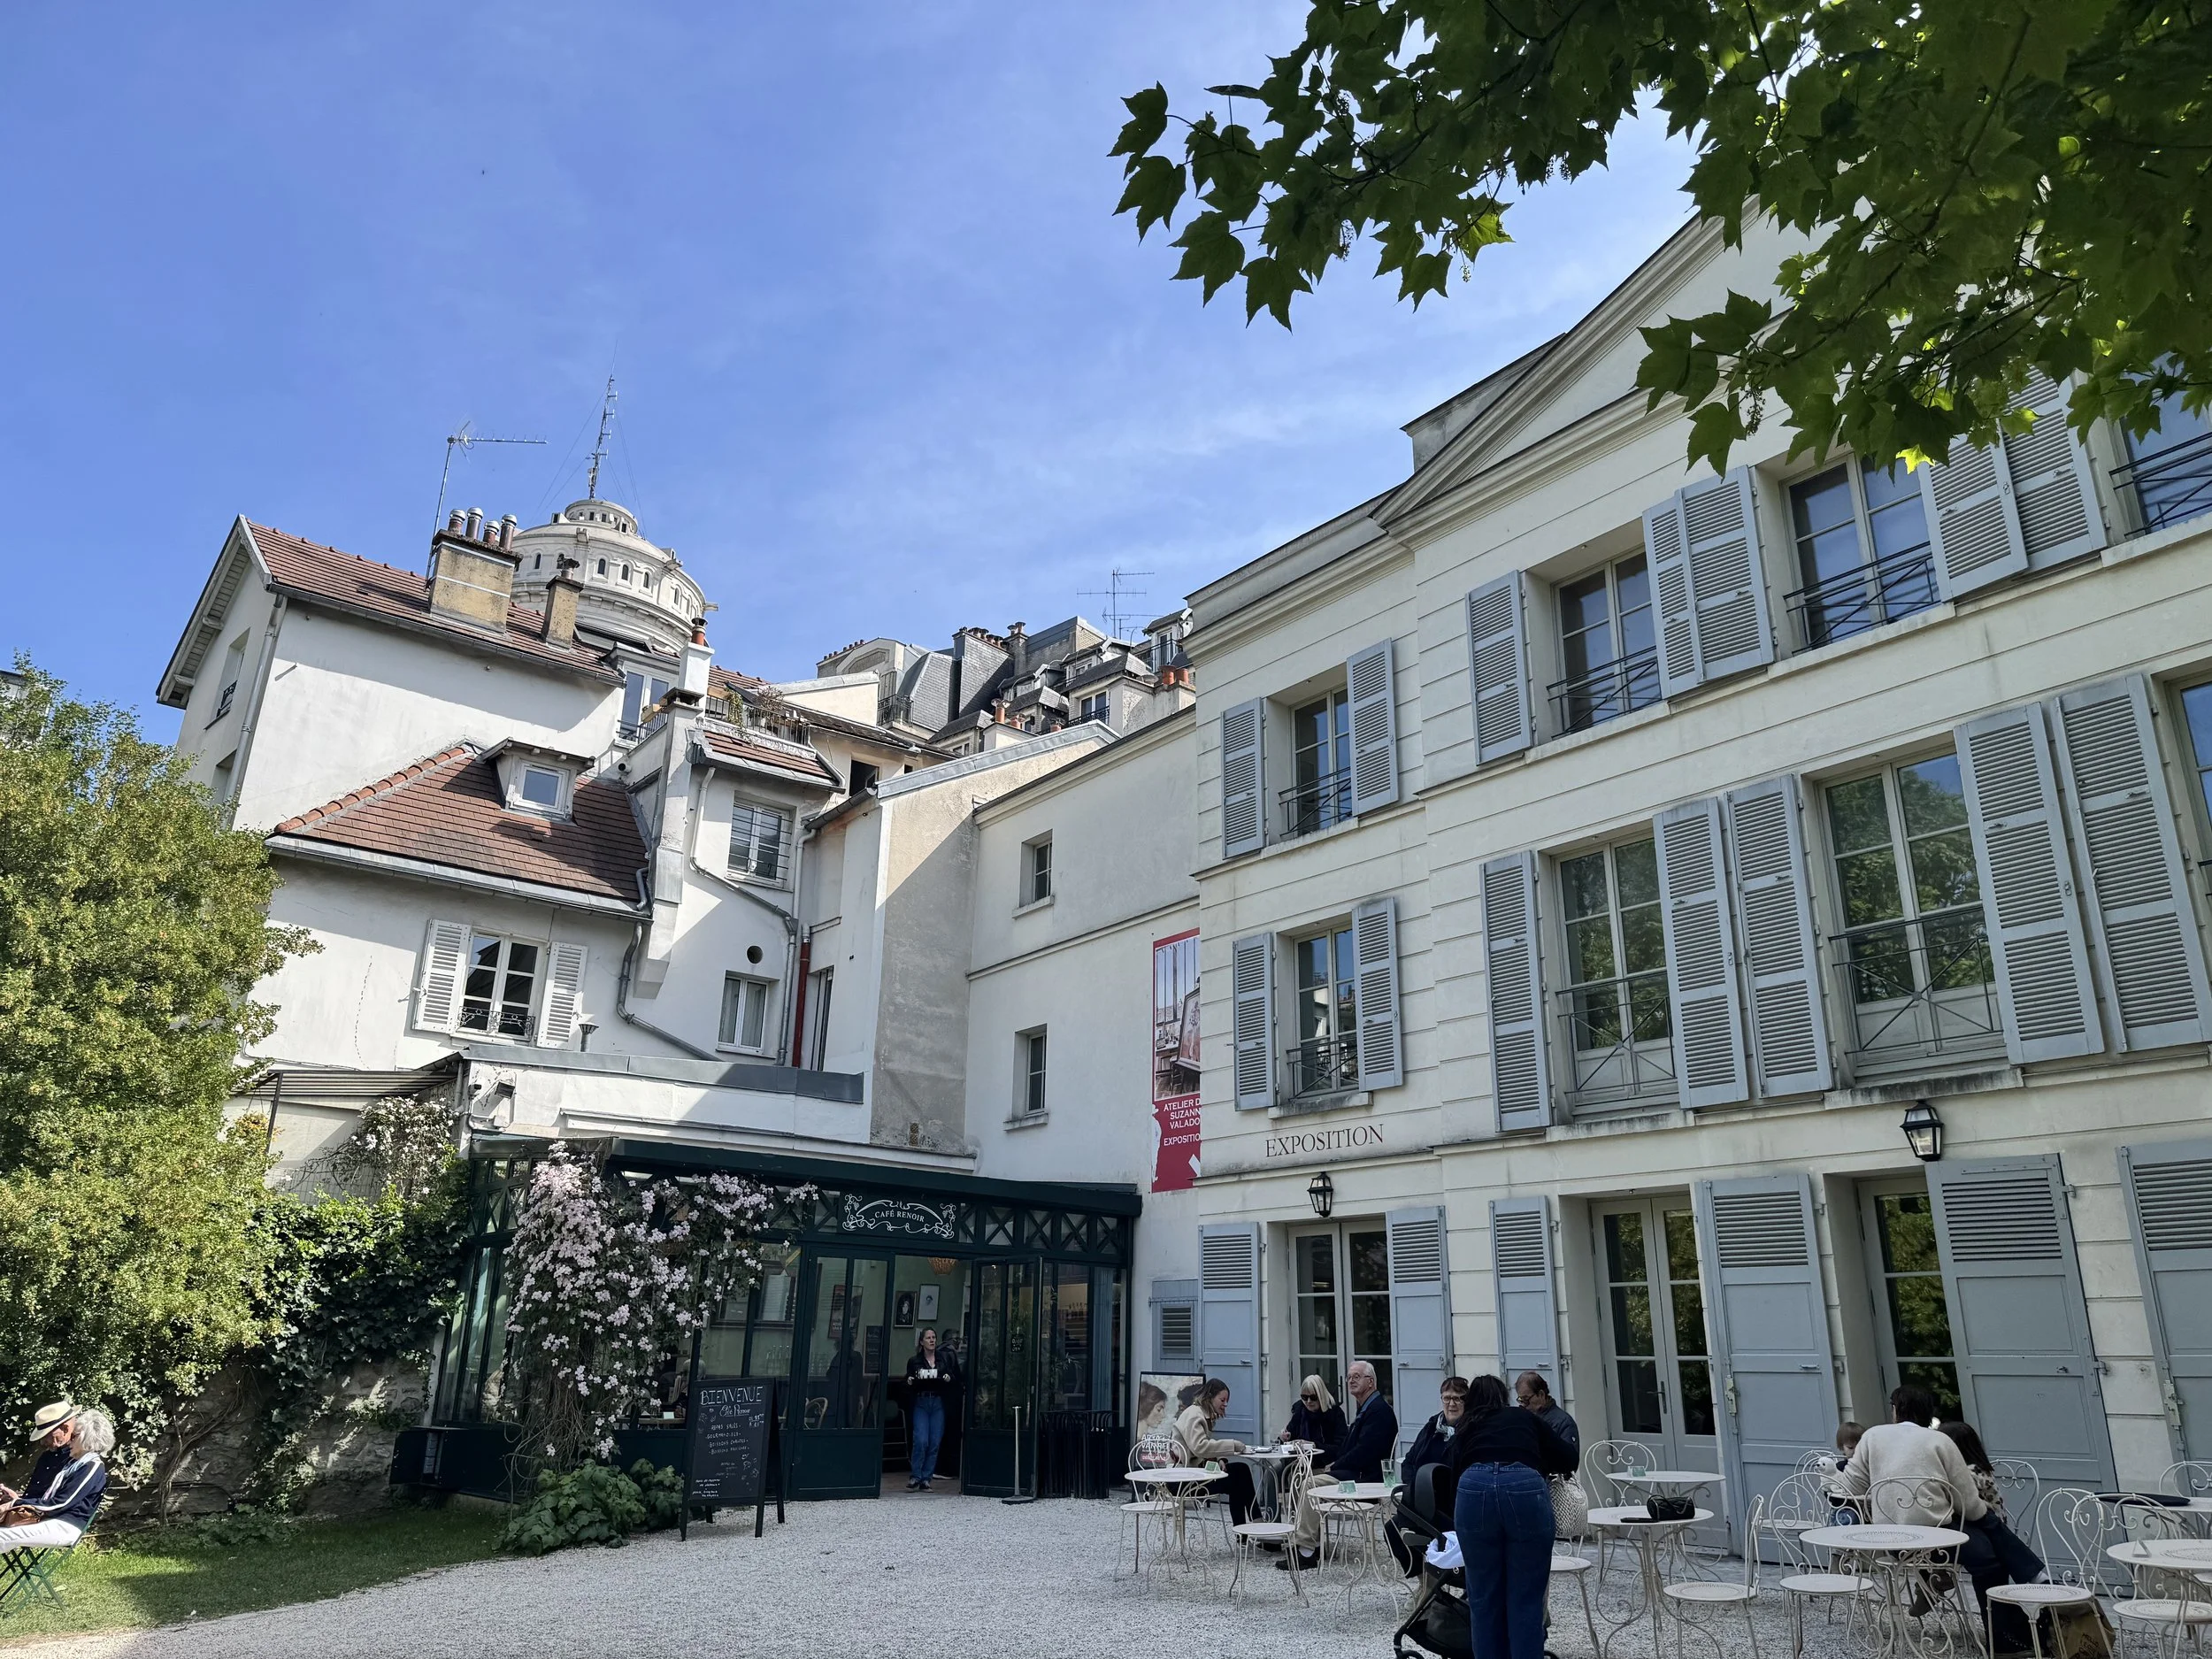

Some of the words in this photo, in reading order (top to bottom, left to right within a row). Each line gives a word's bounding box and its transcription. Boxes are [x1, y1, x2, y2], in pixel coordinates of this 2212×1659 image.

[1164, 1099, 1194, 1112] ATELIER
[1170, 1108, 1201, 1120] SUZANN
[1170, 1118, 1201, 1129] VALADO
[1164, 1133, 1201, 1146] EXPOSITIO
[1265, 1124, 1384, 1157] EXPOSITION
[874, 1210, 895, 1218] CAFÉ
[896, 1210, 925, 1222] RENOIR
[700, 1386, 763, 1405] BIENVENUE
